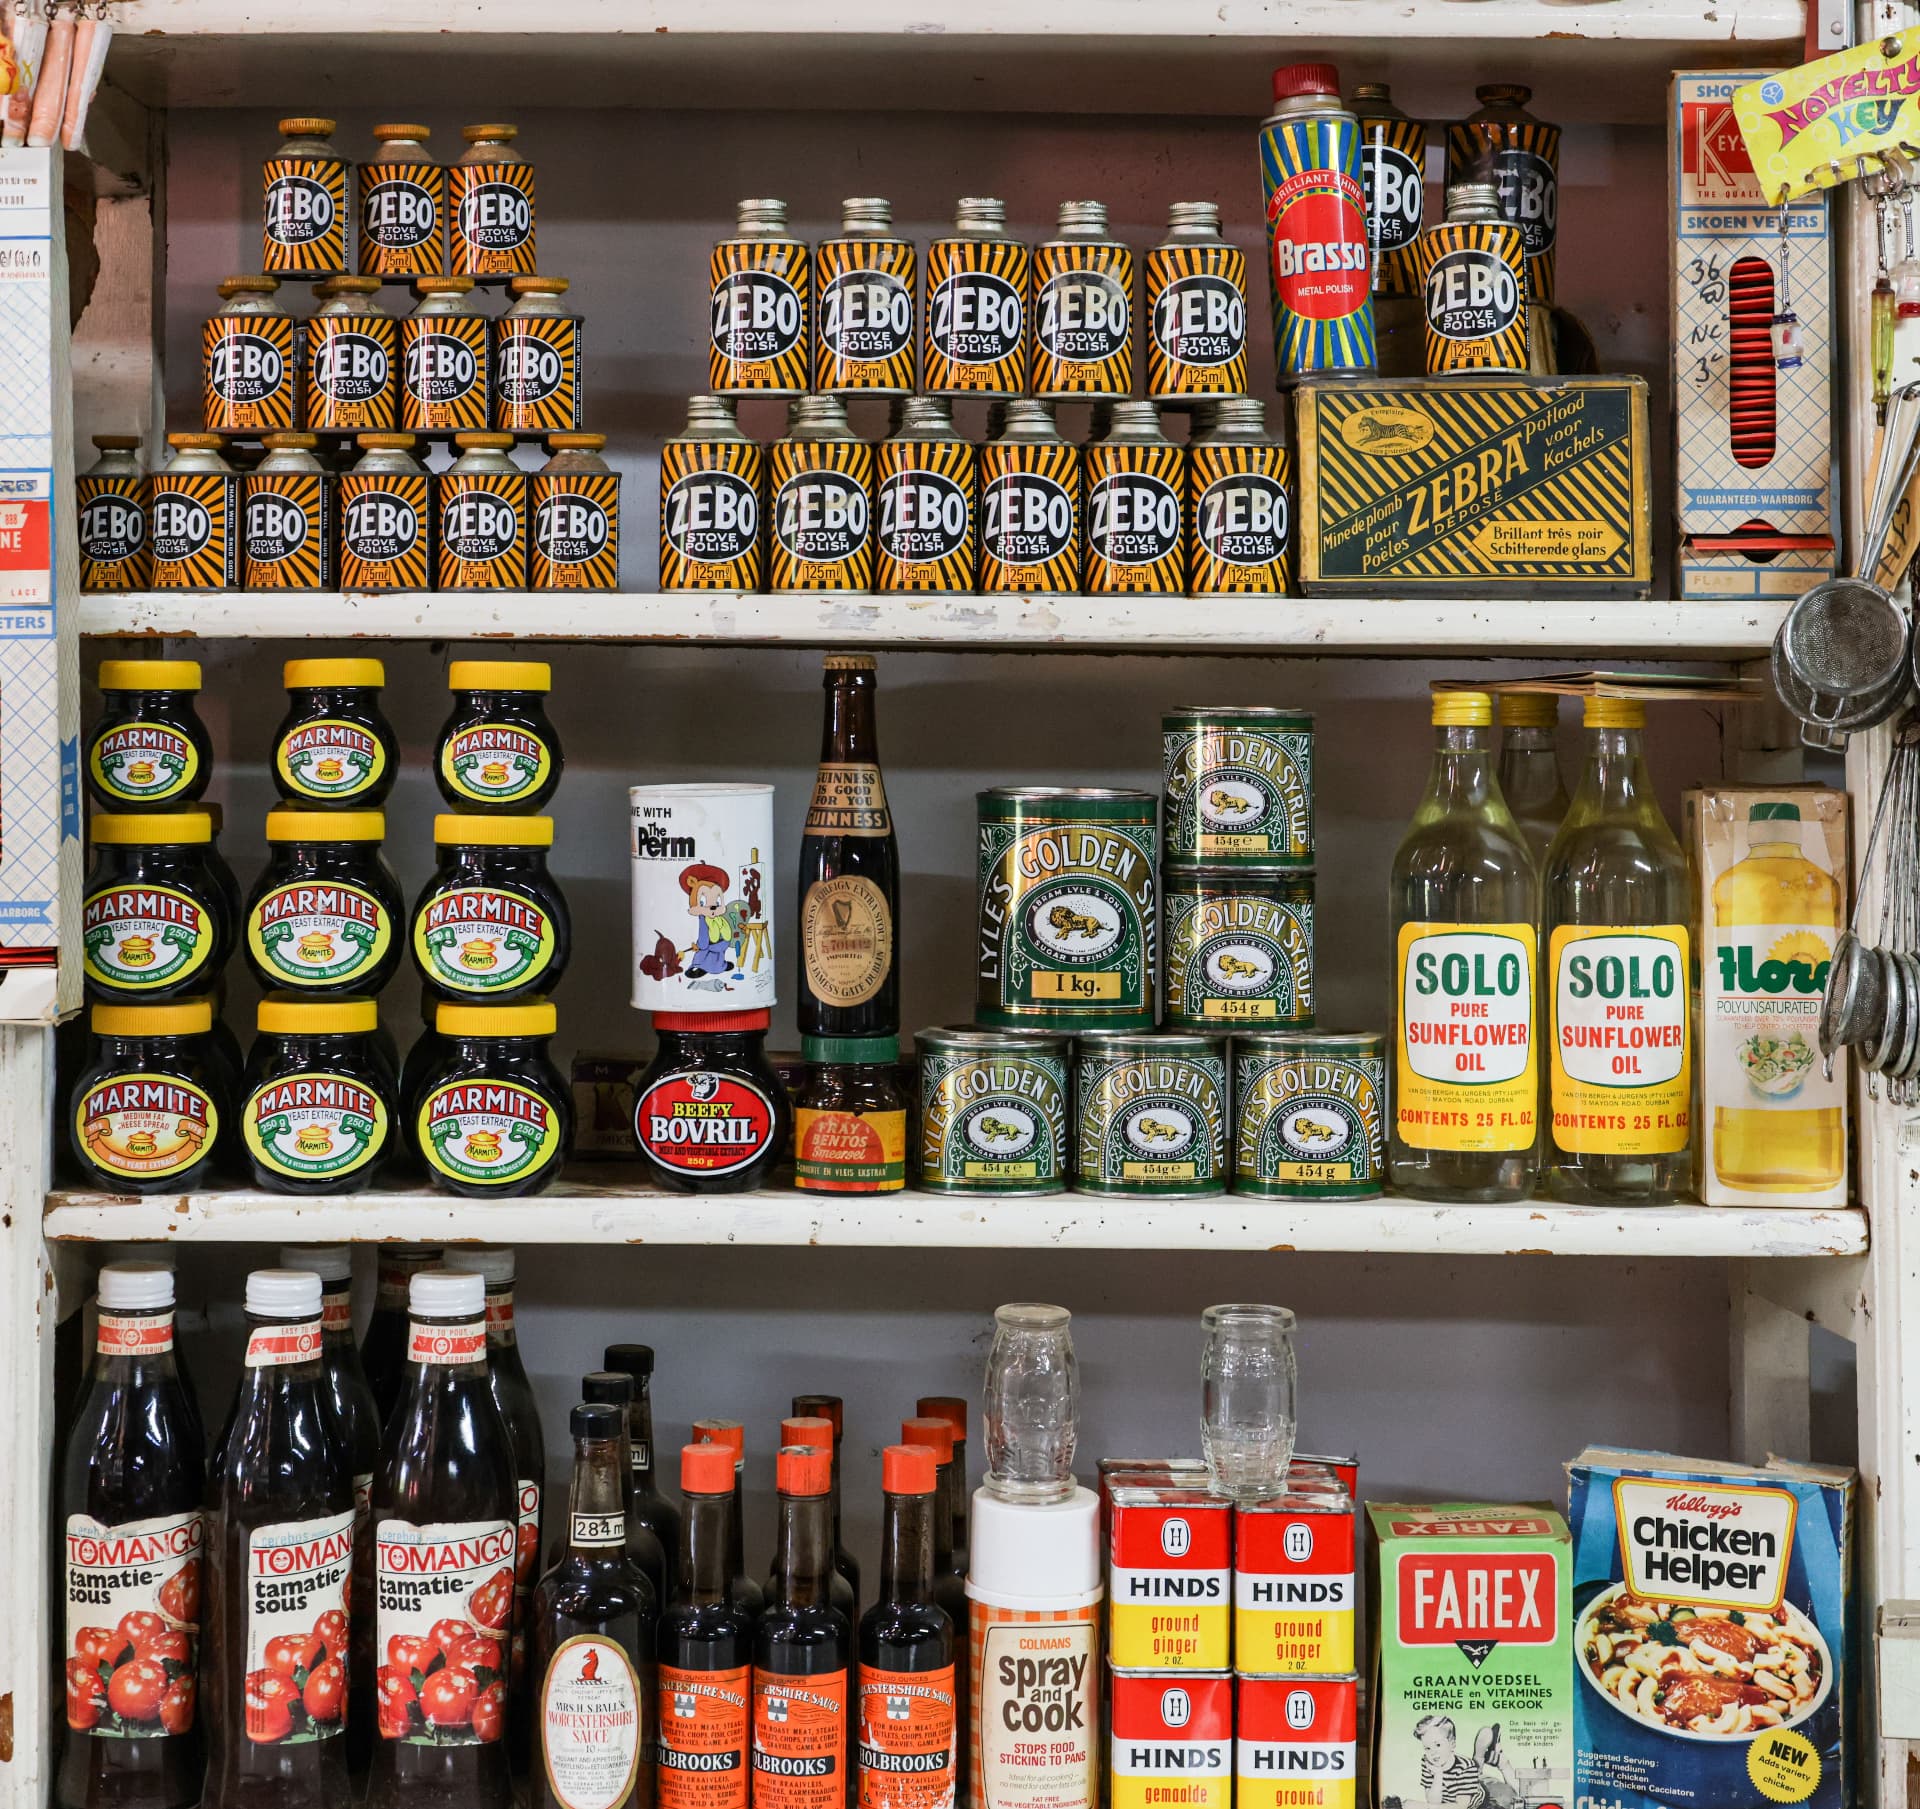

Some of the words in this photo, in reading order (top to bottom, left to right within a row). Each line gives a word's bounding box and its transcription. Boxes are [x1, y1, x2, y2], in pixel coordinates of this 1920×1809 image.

[1274, 174, 1330, 206] BRILLIANT
[1332, 176, 1362, 200] SHINE
[267, 187, 330, 226] ZEBO
[367, 191, 432, 230] ZEBO
[379, 226, 417, 235] STOVE
[1687, 215, 1747, 229] SKOEN
[1751, 215, 1818, 229] VETERS
[377, 233, 419, 241] POLISH
[1279, 239, 1366, 277] Brasso
[1298, 286, 1323, 297] METAL
[1325, 284, 1354, 294] POLISH
[1430, 264, 1514, 320] ZEBO
[714, 285, 798, 338] ZEBO
[935, 287, 1020, 339] ZEBO
[1161, 289, 1241, 341] ZEBO
[1444, 310, 1494, 320] STOVE
[1443, 318, 1498, 331] POLISH
[947, 343, 1001, 353] POLISH
[949, 334, 999, 344] STOVE
[1526, 392, 1586, 444] Potlood
[1544, 419, 1581, 448] voor
[1544, 427, 1605, 470] Kachels
[1406, 432, 1530, 537] ZEBRA
[1696, 495, 1813, 505] GUARANTEED-WAARBORG
[671, 485, 756, 537] ZEBO
[348, 503, 414, 541] ZEBO
[358, 538, 396, 547] STOVE
[686, 532, 736, 542] STOVE
[1365, 522, 1399, 551] pour
[1493, 527, 1543, 540] Brillant
[1577, 528, 1603, 540] noir
[357, 545, 398, 554] POLISH
[685, 541, 739, 551] POLISH
[1363, 538, 1409, 573] Poëles
[1490, 542, 1570, 556] Schitterende
[1572, 543, 1607, 560] glans
[103, 731, 184, 754] MARMITE
[456, 729, 537, 755] MARMITE
[818, 785, 827, 795] IS
[834, 785, 871, 796] GOOD
[815, 796, 838, 805] FOR
[847, 796, 872, 806] YOU
[643, 807, 672, 818] WITH
[648, 822, 667, 837] The
[638, 827, 696, 857] Perm
[1017, 834, 1137, 882] GOLDEN
[265, 889, 373, 922] MARMITE
[1066, 886, 1091, 895] LYLE
[1103, 893, 1123, 913] SONS
[290, 918, 311, 929] YEAST
[313, 917, 345, 929] EXTRACT
[349, 925, 367, 935] 250
[981, 876, 1014, 979] LYLE'S
[1033, 940, 1066, 961] SUGAR
[1071, 942, 1120, 963] REFINERS
[1416, 952, 1520, 996] SOLO
[1569, 955, 1674, 999] SOLO
[1072, 974, 1101, 997] kg.
[1451, 1002, 1489, 1018] PURE
[1717, 1000, 1818, 1014] POLYUNSATURATED
[1409, 1023, 1527, 1046] SUNFLOWER
[1562, 1025, 1682, 1048] SUNFLOWER
[1455, 1053, 1485, 1072] OIL
[89, 1084, 202, 1118] MARMITE
[261, 1082, 371, 1115] MARMITE
[433, 1088, 542, 1122] MARMITE
[123, 1112, 152, 1121] MEDIUM
[672, 1103, 733, 1117] BEEFY
[1239, 1091, 1270, 1168] LYLE'S
[1266, 1066, 1361, 1100] GOLDEN
[1359, 1091, 1382, 1170] SYRUP
[1400, 1108, 1468, 1127] CONTENTS
[1476, 1112, 1494, 1127] 25
[1501, 1112, 1518, 1126] FL.
[143, 1121, 170, 1130] SPREAD
[650, 1116, 757, 1144] BOVRIL
[819, 1119, 860, 1134] FRAY
[812, 1134, 868, 1148] BENTOS
[1296, 1164, 1322, 1177] 454
[1666, 1493, 1743, 1519] Kellogg's
[67, 1519, 203, 1566] TOMANGO
[1170, 1527, 1182, 1547] H
[1633, 1516, 1776, 1558] Chicken
[378, 1529, 514, 1572] TOMANGO
[1645, 1551, 1766, 1591] Helper
[255, 1568, 346, 1598] tamatie-
[379, 1576, 474, 1596] tamatie-
[1130, 1577, 1221, 1597] HINDS
[1252, 1582, 1344, 1603] HINDS
[379, 1595, 422, 1612] sous
[1414, 1569, 1543, 1629] FAREX
[1152, 1614, 1199, 1633] ground
[1019, 1637, 1071, 1651] COLMANS
[1153, 1636, 1197, 1655] ginger
[1164, 1656, 1170, 1665] 2
[1413, 1675, 1542, 1688] GRAANVOEDSEL
[812, 1694, 840, 1713] SAUCE
[1030, 1687, 1062, 1703] and
[1403, 1689, 1464, 1699] MINERALE
[1487, 1688, 1553, 1698] VITAMINES
[1412, 1701, 1463, 1711] GEMENG
[1470, 1700, 1485, 1709] EN
[1492, 1700, 1543, 1709] GEKOOK
[549, 1710, 635, 1728] WORCESTERSHIRE
[572, 1729, 609, 1744] SAUCE
[1014, 1743, 1047, 1754] STOPS
[1050, 1742, 1075, 1754] FOOD
[1131, 1748, 1222, 1768] HINDS
[1770, 1740, 1809, 1767] NEW
[859, 1749, 944, 1770] HOLBROOKS
[1000, 1753, 1046, 1766] STICKING
[1049, 1755, 1062, 1766] TO
[1065, 1751, 1086, 1765] PANS
[1577, 1749, 1621, 1763] Suggested
[1623, 1755, 1659, 1768] Serving:
[1759, 1755, 1780, 1769] Adds
[1780, 1763, 1811, 1782] variety
[1763, 1776, 1795, 1793] chicken
[1777, 1772, 1786, 1780] to
[1145, 1784, 1208, 1804] gemaalde
[1588, 1778, 1610, 1787] make
[1613, 1780, 1646, 1792] Chicken
[1649, 1785, 1695, 1797] Cacciatore
